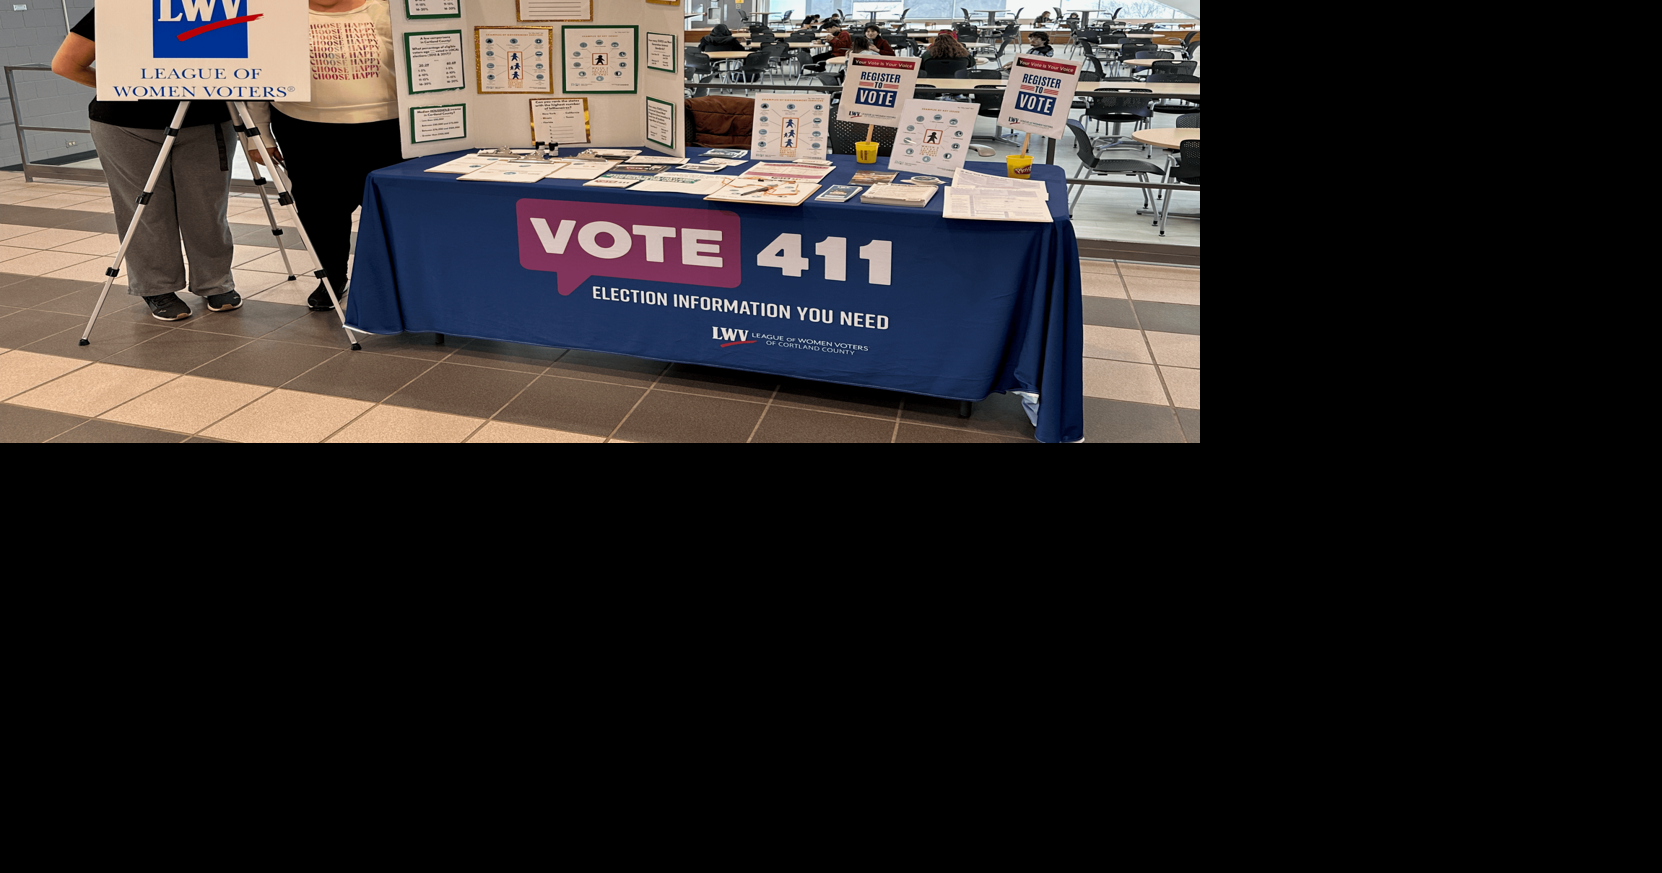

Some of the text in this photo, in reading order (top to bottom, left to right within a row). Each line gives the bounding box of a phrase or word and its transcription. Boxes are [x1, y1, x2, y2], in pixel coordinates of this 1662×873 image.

[141, 68, 263, 79] LEAGUE OF
[860, 71, 901, 83] REGISTER
[1022, 73, 1062, 89] REGISTER
[112, 86, 196, 97] WOMEN
[860, 89, 894, 106] VOTE
[1035, 85, 1044, 94] TO
[1019, 93, 1053, 113] VOTE
[529, 217, 724, 268] VOTE
[757, 232, 893, 286] 411
[592, 285, 889, 331] ELECTION INFORMATION YOU NEED
[712, 326, 749, 342] LWV
[751, 332, 784, 341] LEAGUE
[797, 338, 833, 347] WOMEN
[834, 342, 869, 351] VOTERS
[778, 342, 820, 352] CORTLAND
[821, 347, 855, 355] COUNTY
